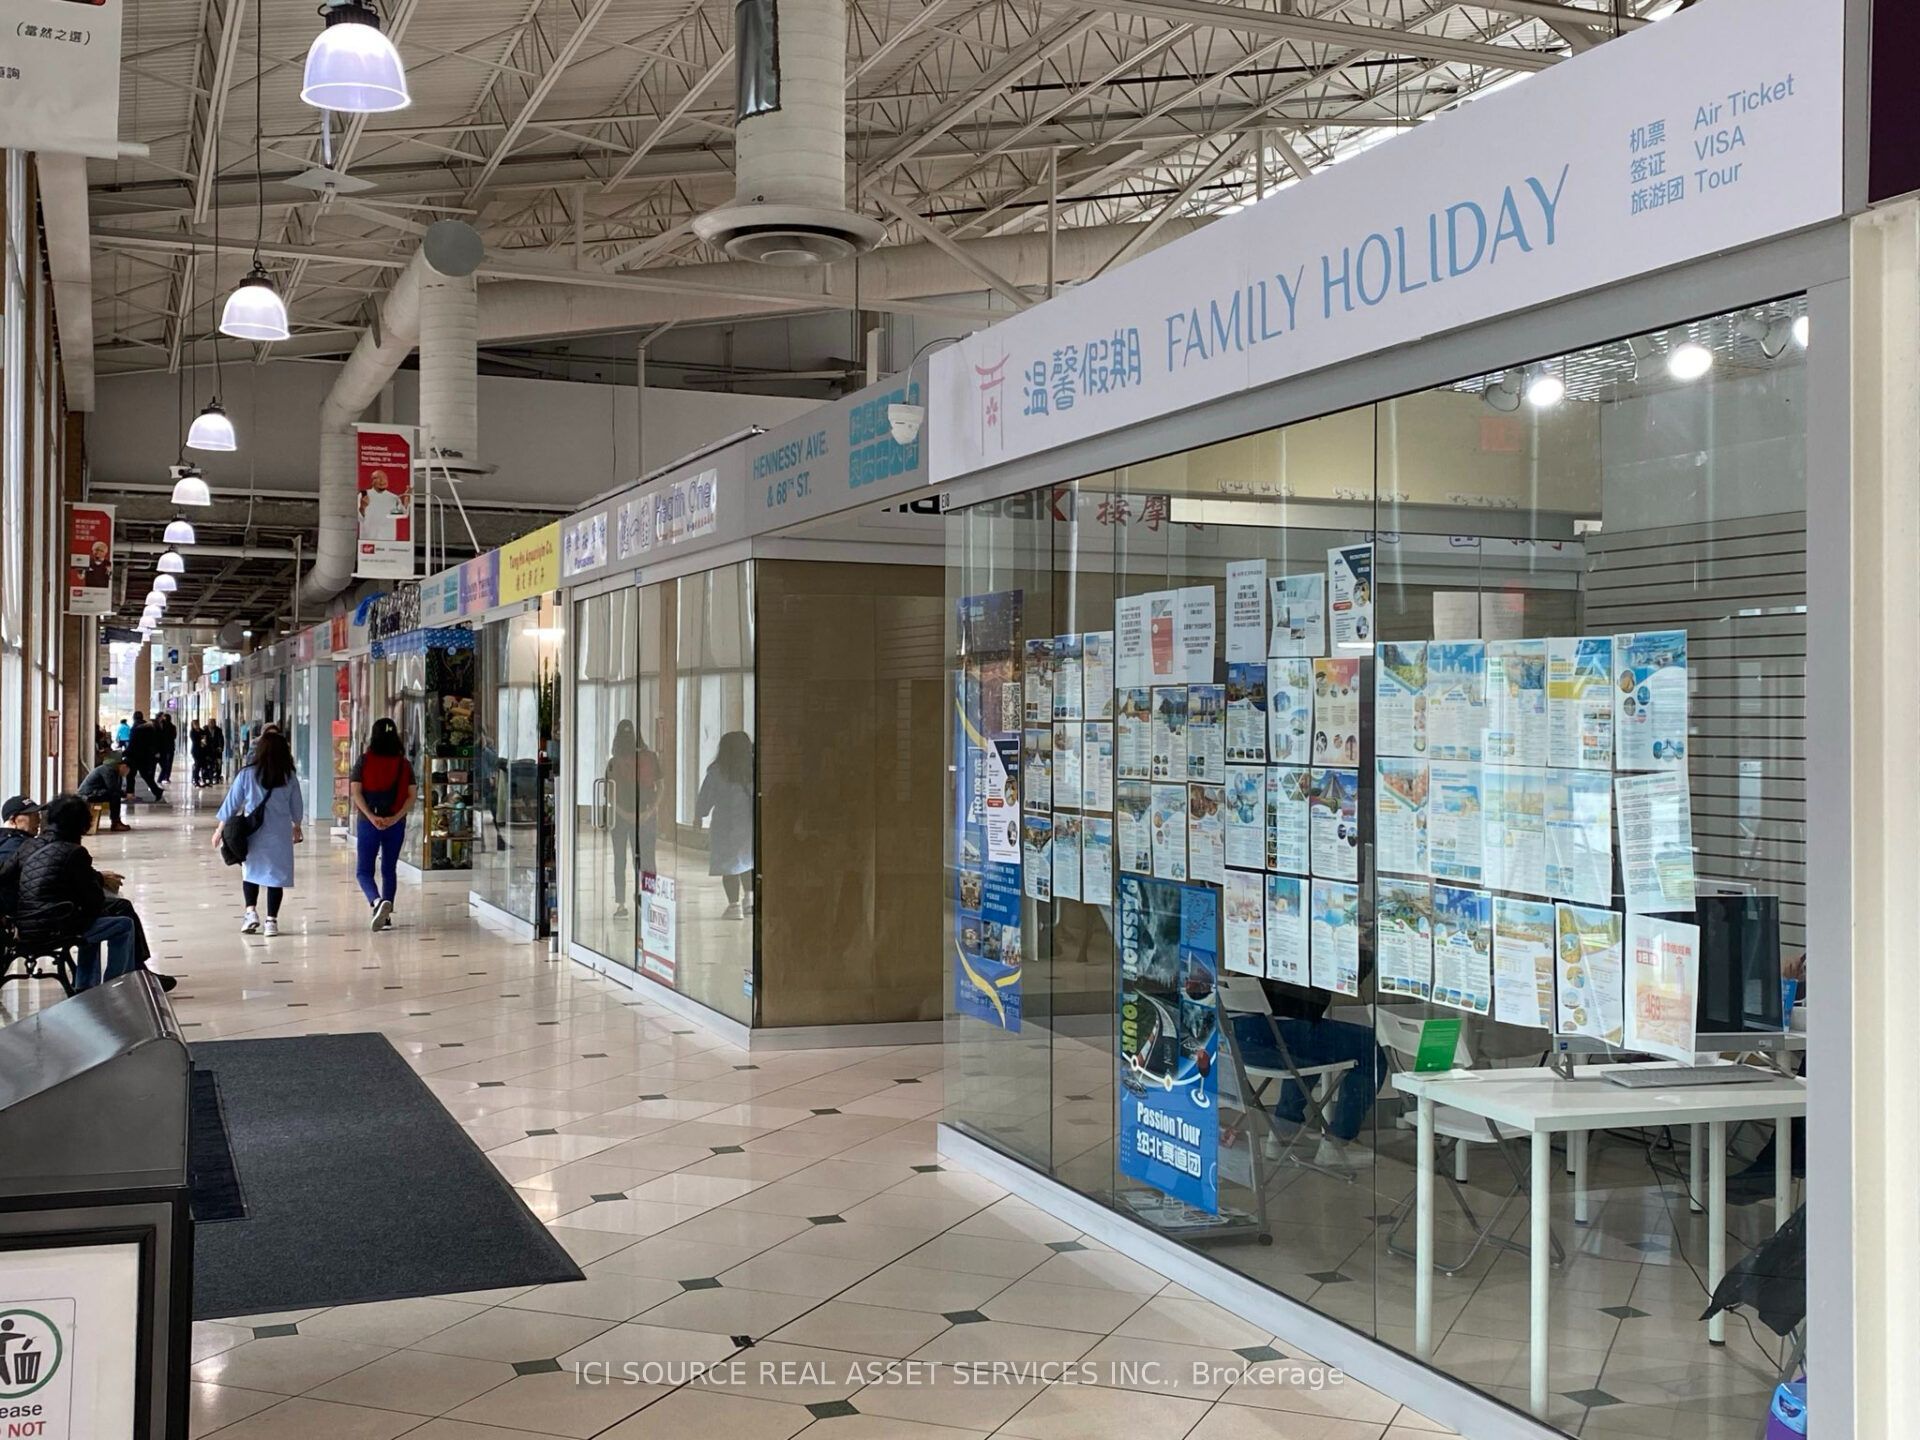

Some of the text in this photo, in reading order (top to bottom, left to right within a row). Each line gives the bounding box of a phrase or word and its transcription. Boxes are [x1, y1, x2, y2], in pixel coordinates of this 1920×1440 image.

[1694, 73, 1795, 131] Air Ticket
[1630, 119, 1666, 153] 机票
[1694, 125, 1746, 161] VISA
[1630, 151, 1666, 184] 签证
[1694, 162, 1743, 193] Tour
[1630, 176, 1685, 216] 旅游团
[1165, 163, 1570, 373] FAMILY HOLIDAY
[1023, 327, 1142, 417] 温馨假期
[753, 431, 829, 481] HENNESSY AVE.
[767, 486, 774, 508] &
[1122, 878, 1139, 982] PASSION
[1137, 1101, 1201, 1147] Passion Tour
[1136, 1129, 1201, 1178] 纽北赛道团
[8, 1421, 47, 1438] NOT
